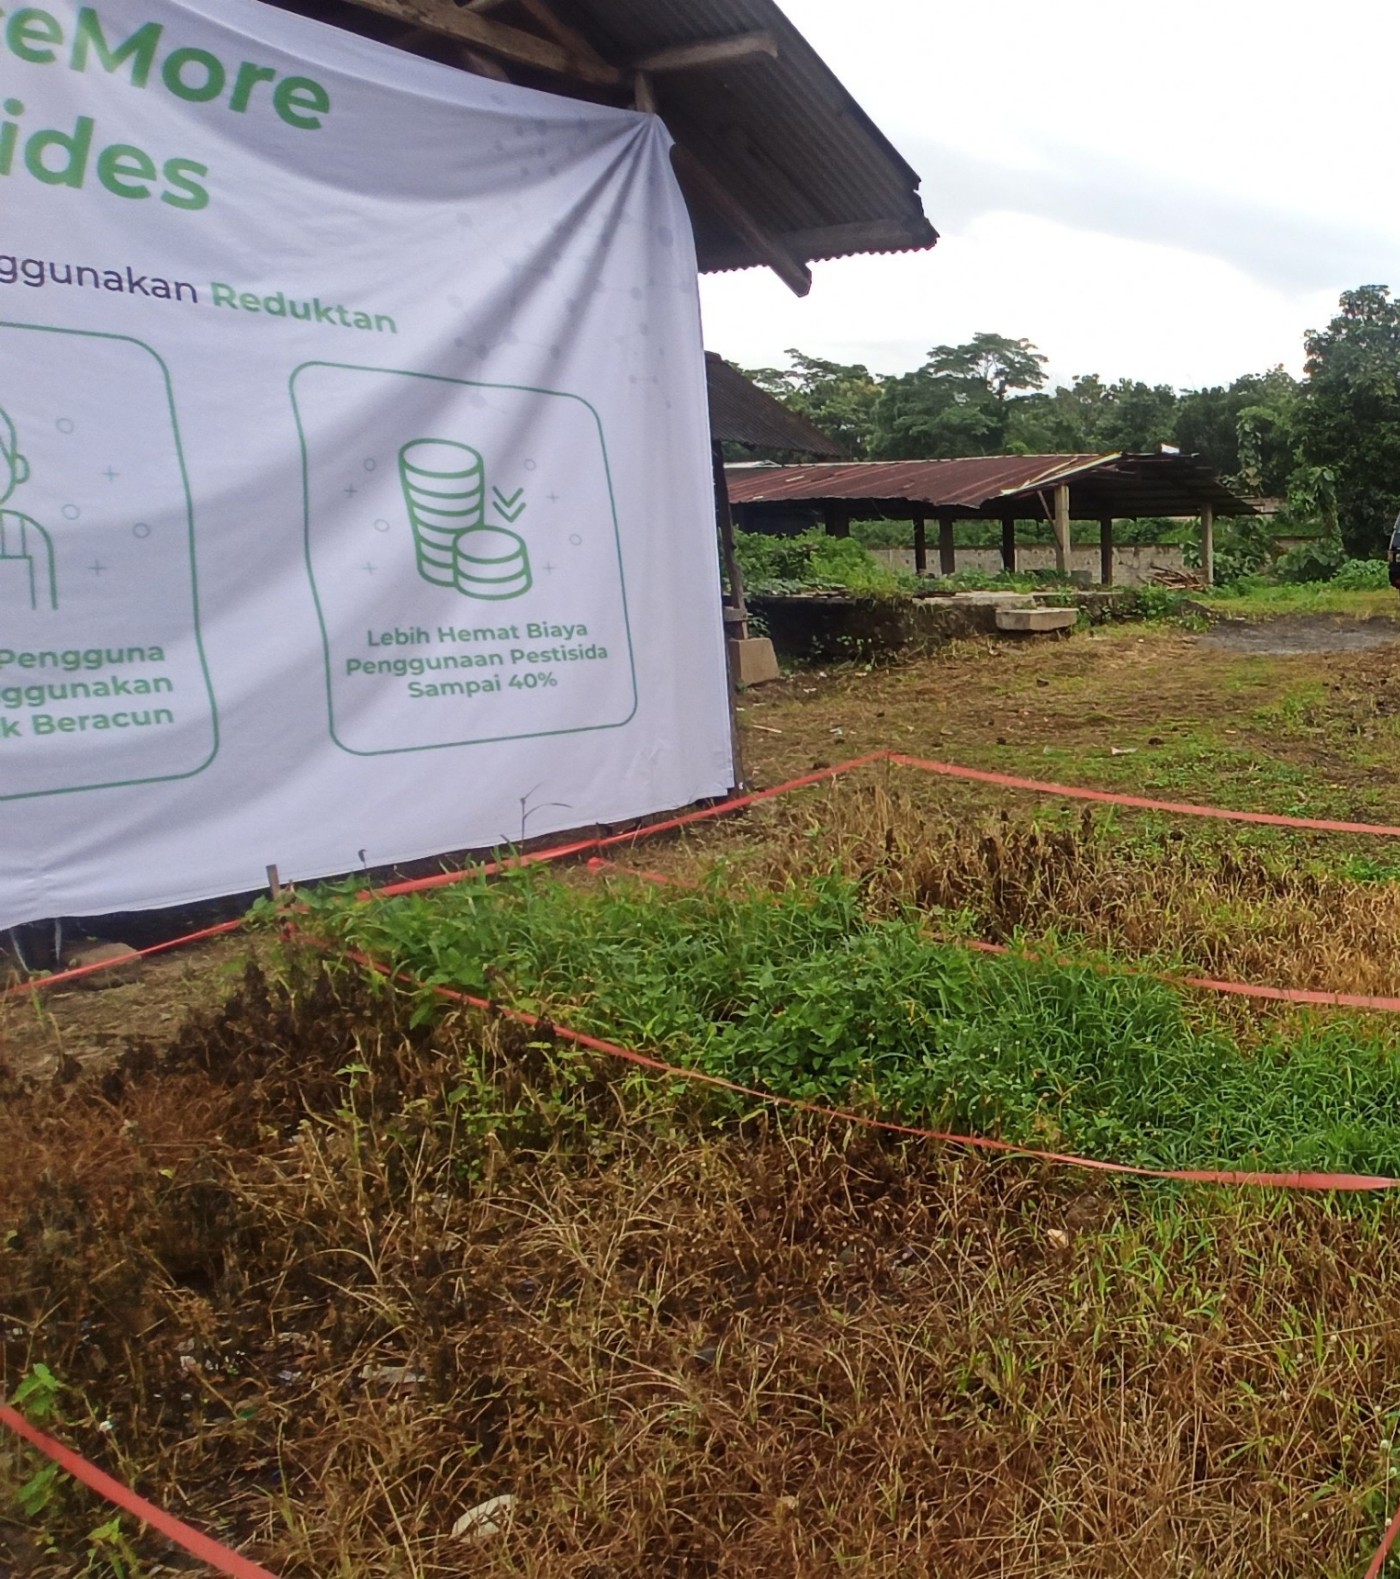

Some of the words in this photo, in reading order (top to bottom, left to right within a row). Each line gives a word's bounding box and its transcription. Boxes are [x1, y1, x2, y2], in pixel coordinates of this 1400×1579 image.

[210, 281, 398, 334] Reduktan
[367, 626, 430, 647] Lebih
[437, 624, 520, 644] Hemat
[526, 621, 589, 641] Biaya
[346, 652, 504, 677] Penggunaan
[510, 644, 608, 665] Pestisida
[0, 675, 174, 709] ggunakan
[408, 674, 501, 698] Sampai
[508, 672, 558, 690] 40%
[32, 708, 174, 736] Beracun
